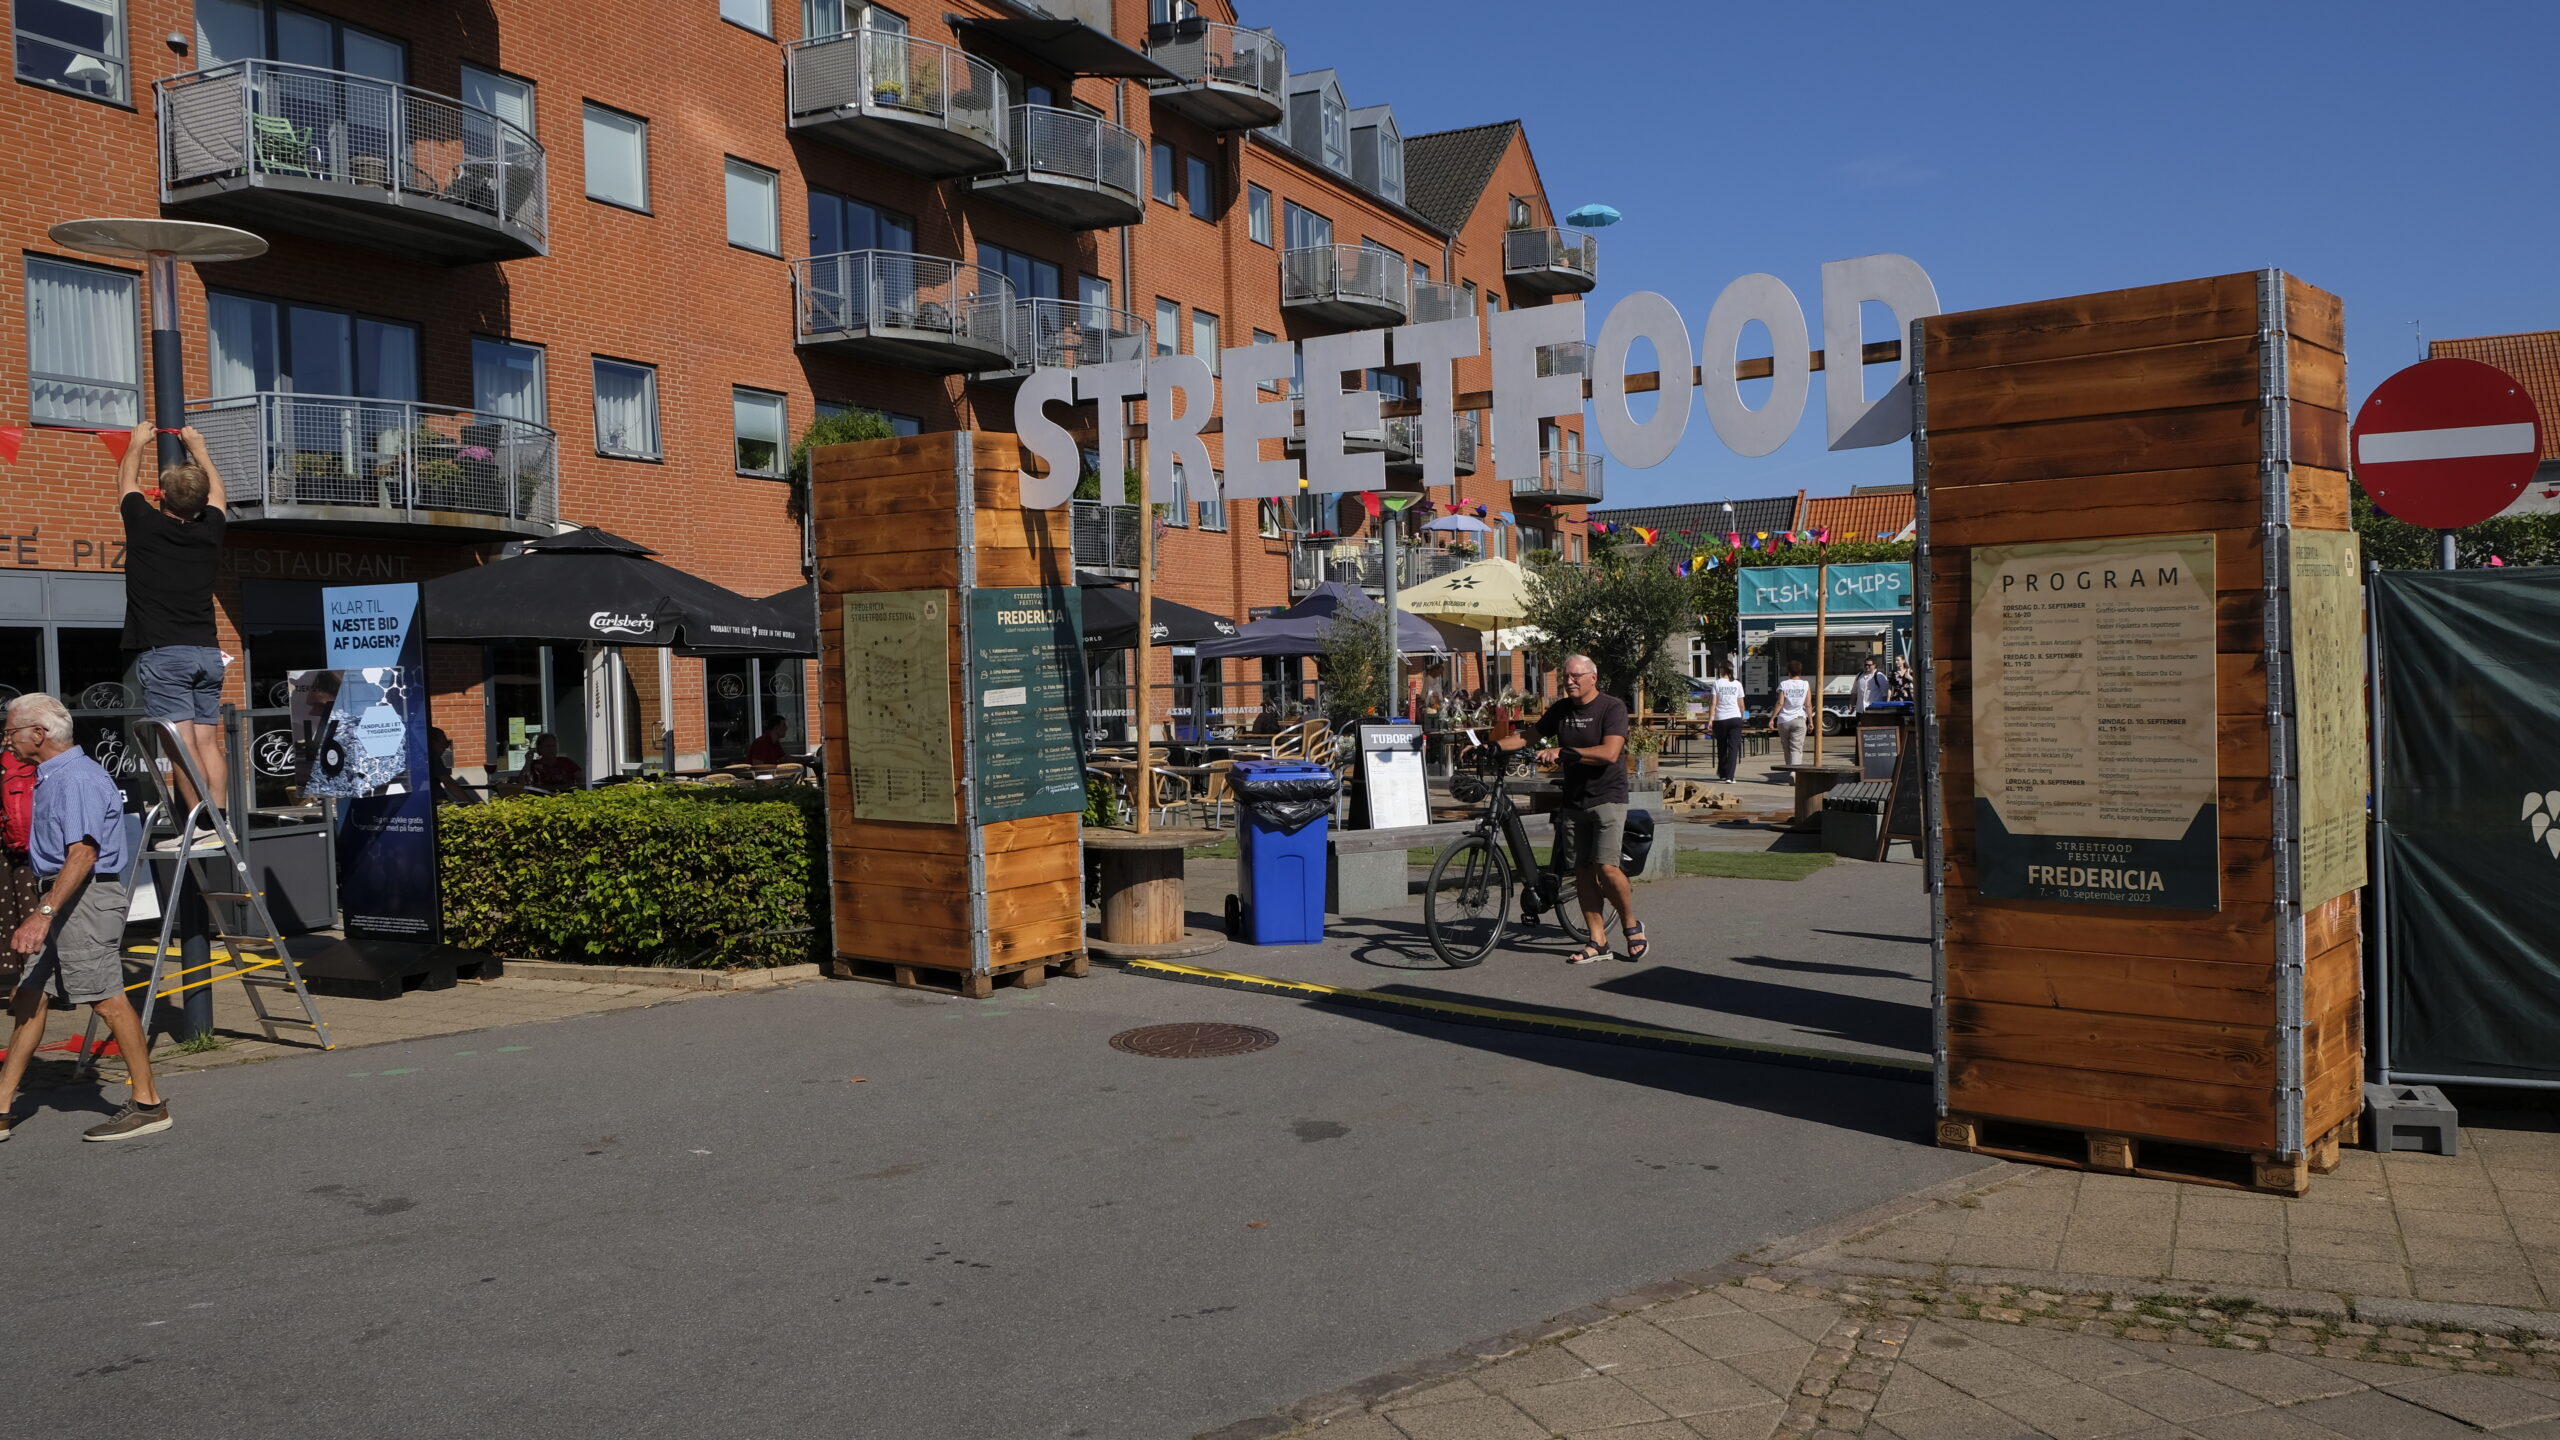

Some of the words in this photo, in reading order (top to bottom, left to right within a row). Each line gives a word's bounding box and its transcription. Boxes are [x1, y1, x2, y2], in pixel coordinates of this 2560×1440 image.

[1013, 254, 1942, 510] STREETFOOD
[73, 540, 127, 568] PIZ
[2002, 567, 2178, 592] PROGRAM
[1756, 583, 1809, 606] FISH
[1834, 573, 1901, 596] CHIPS
[331, 600, 363, 615] KLAR
[366, 599, 384, 613] TIL
[851, 602, 885, 612] FREDERICIA
[332, 617, 375, 632] NÆSTE
[378, 616, 398, 630] BID
[589, 611, 654, 634] Carlsberg
[851, 612, 888, 623] STREETFOOD
[888, 611, 916, 621] FESTIVAL
[997, 609, 1065, 626] FREDERICIA
[710, 625, 732, 634] PROBABLY
[732, 625, 740, 634] THE
[741, 626, 751, 635] BEST
[758, 627, 768, 636] BEER
[774, 629, 782, 638] THE
[782, 629, 795, 639] WORLD
[333, 636, 350, 650] AF
[352, 634, 401, 650] DAGEN?
[366, 727, 402, 735] TYGGEGUMMI
[1371, 733, 1413, 744] TUBORG
[95, 740, 137, 778] Efes
[260, 741, 295, 772] Efe
[407, 817, 423, 825] gratis
[2056, 841, 2133, 854] STREETFOOD
[2068, 852, 2126, 864] FESTIVAL
[2028, 865, 2165, 891] FREDERICIA
[2040, 888, 2048, 897] 7.
[2058, 888, 2071, 898] 10.
[2073, 890, 2125, 901] september
[2128, 892, 2151, 902] 2023
